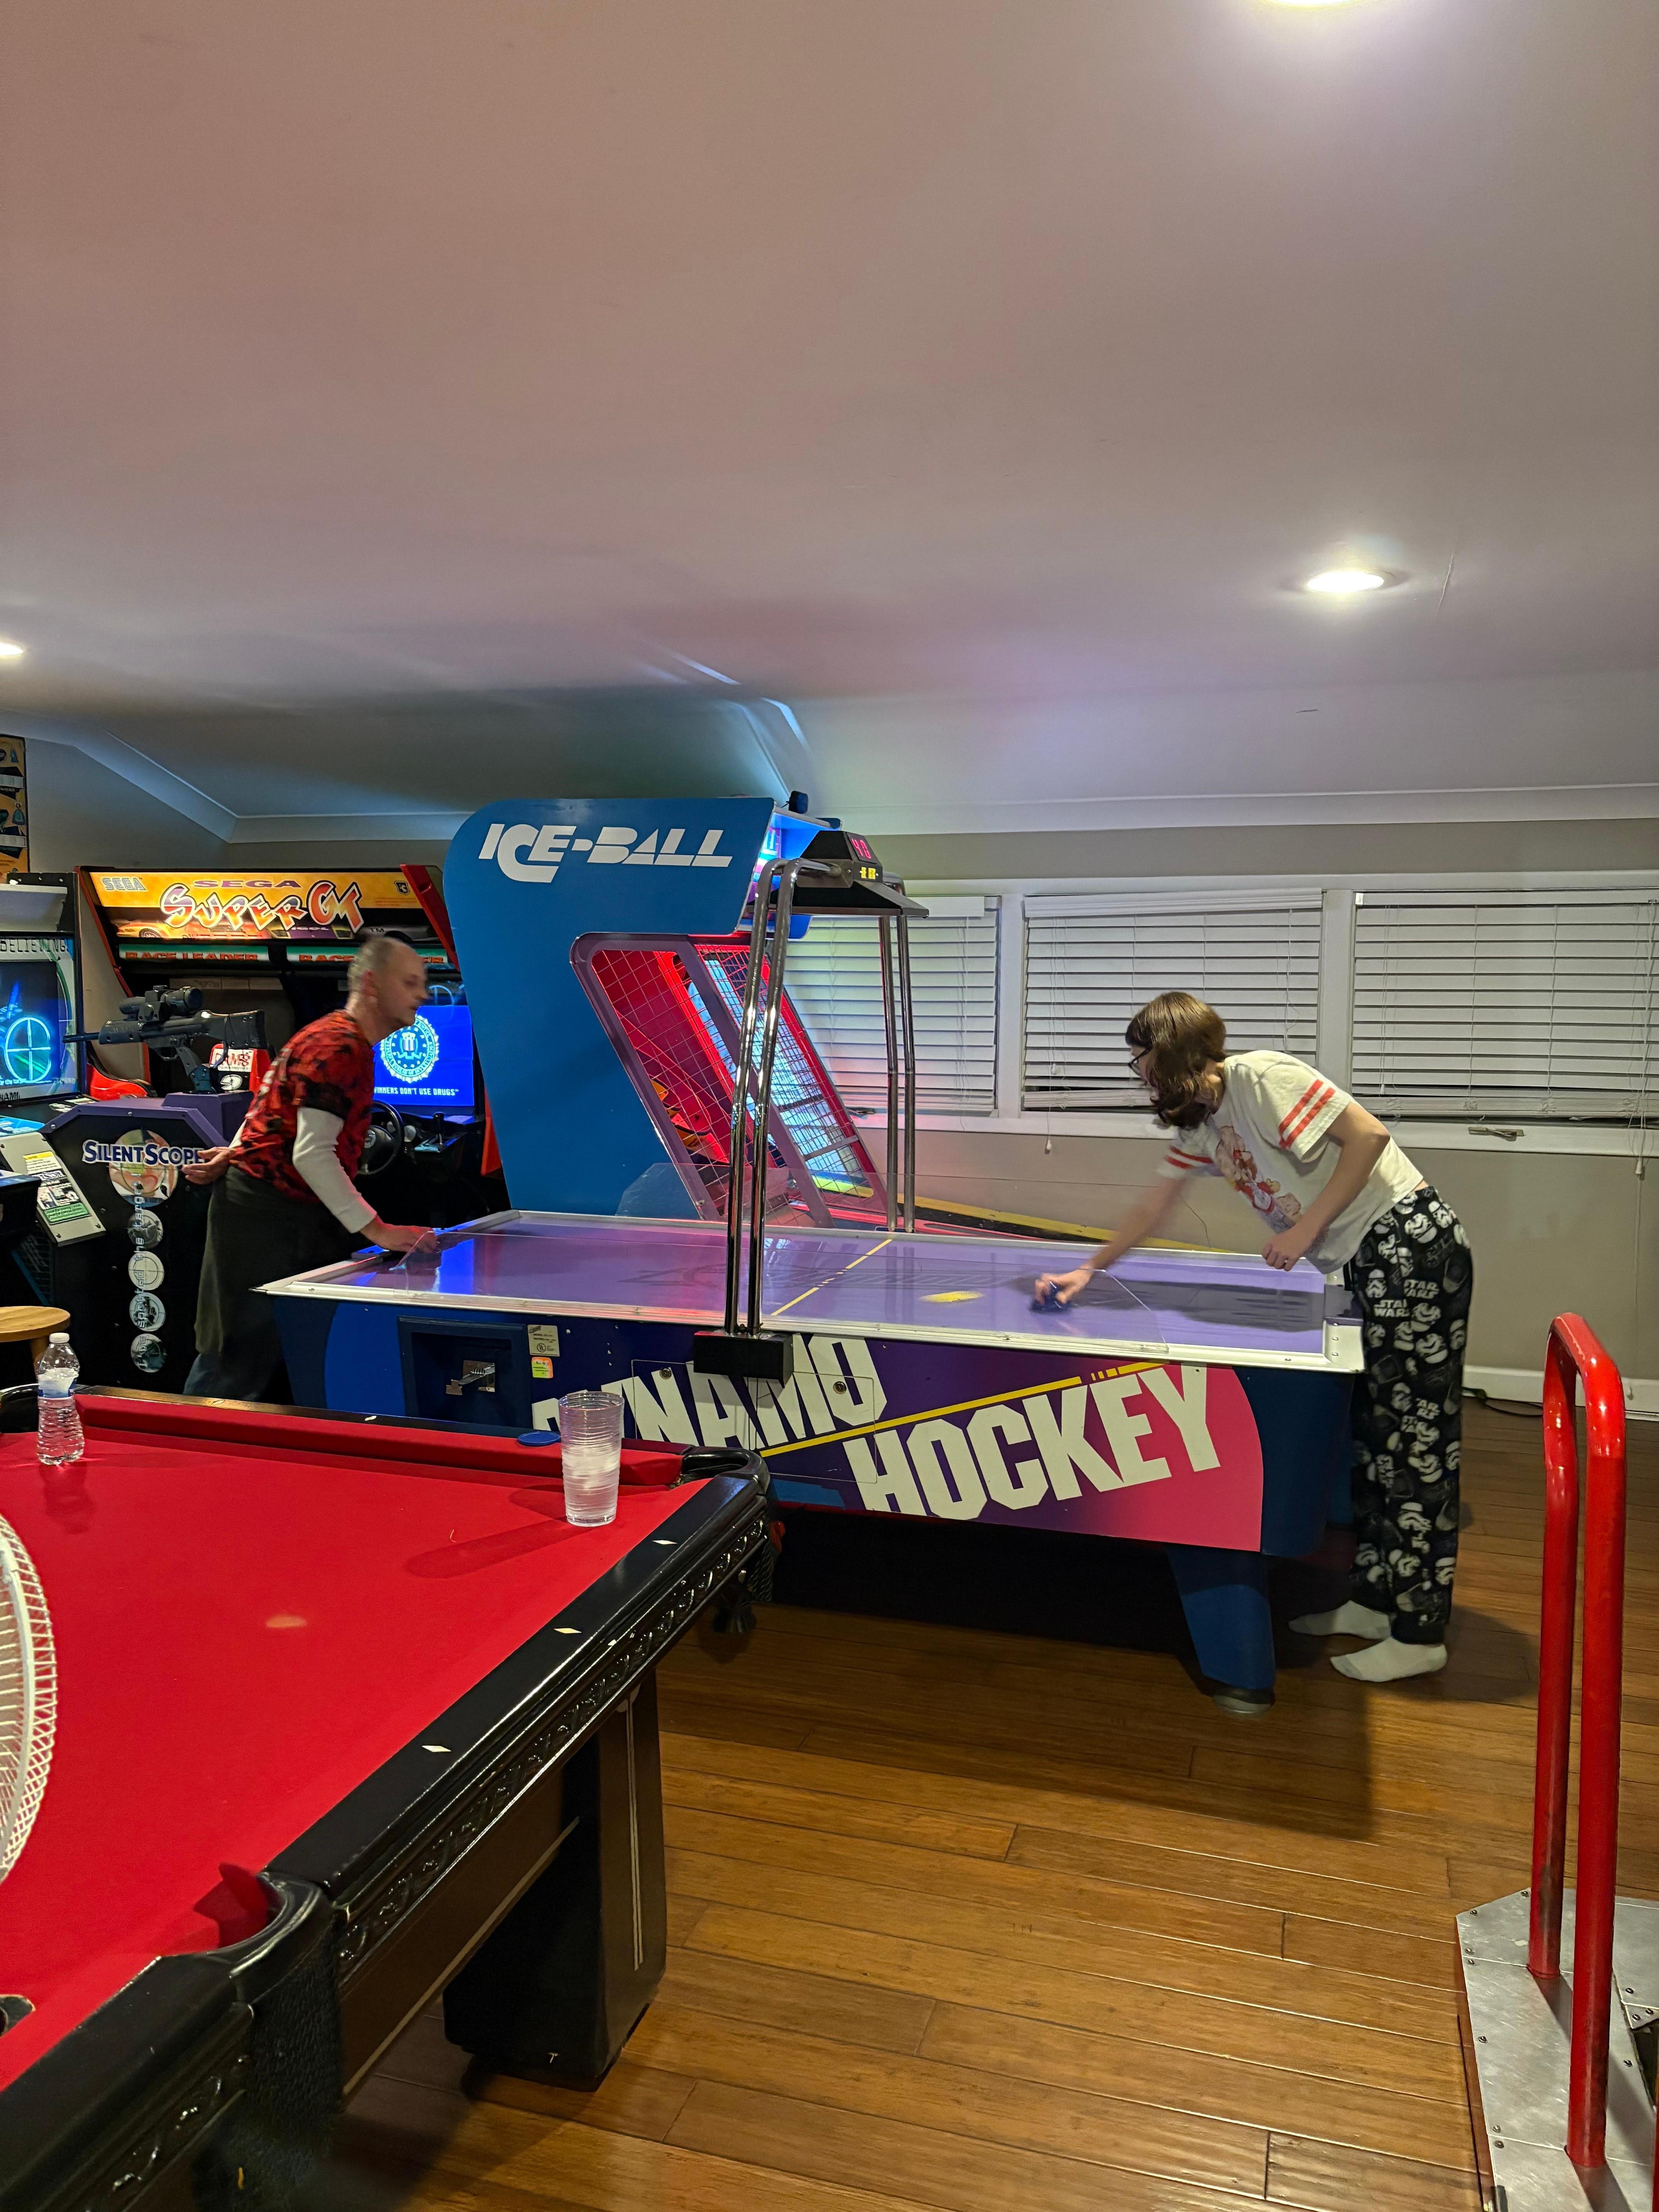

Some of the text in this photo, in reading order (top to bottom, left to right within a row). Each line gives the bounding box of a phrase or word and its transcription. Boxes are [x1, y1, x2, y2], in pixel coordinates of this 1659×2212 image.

[479, 823, 733, 883] ICE-BALL
[101, 877, 147, 891] SEGA
[193, 880, 302, 888] SEGA
[160, 880, 363, 934] SUPER GT
[125, 951, 177, 960] RACE
[400, 1087, 417, 1096] DON'T
[1374, 1308, 1410, 1317] WAR
[842, 1362, 1221, 1520] HOCKEY
